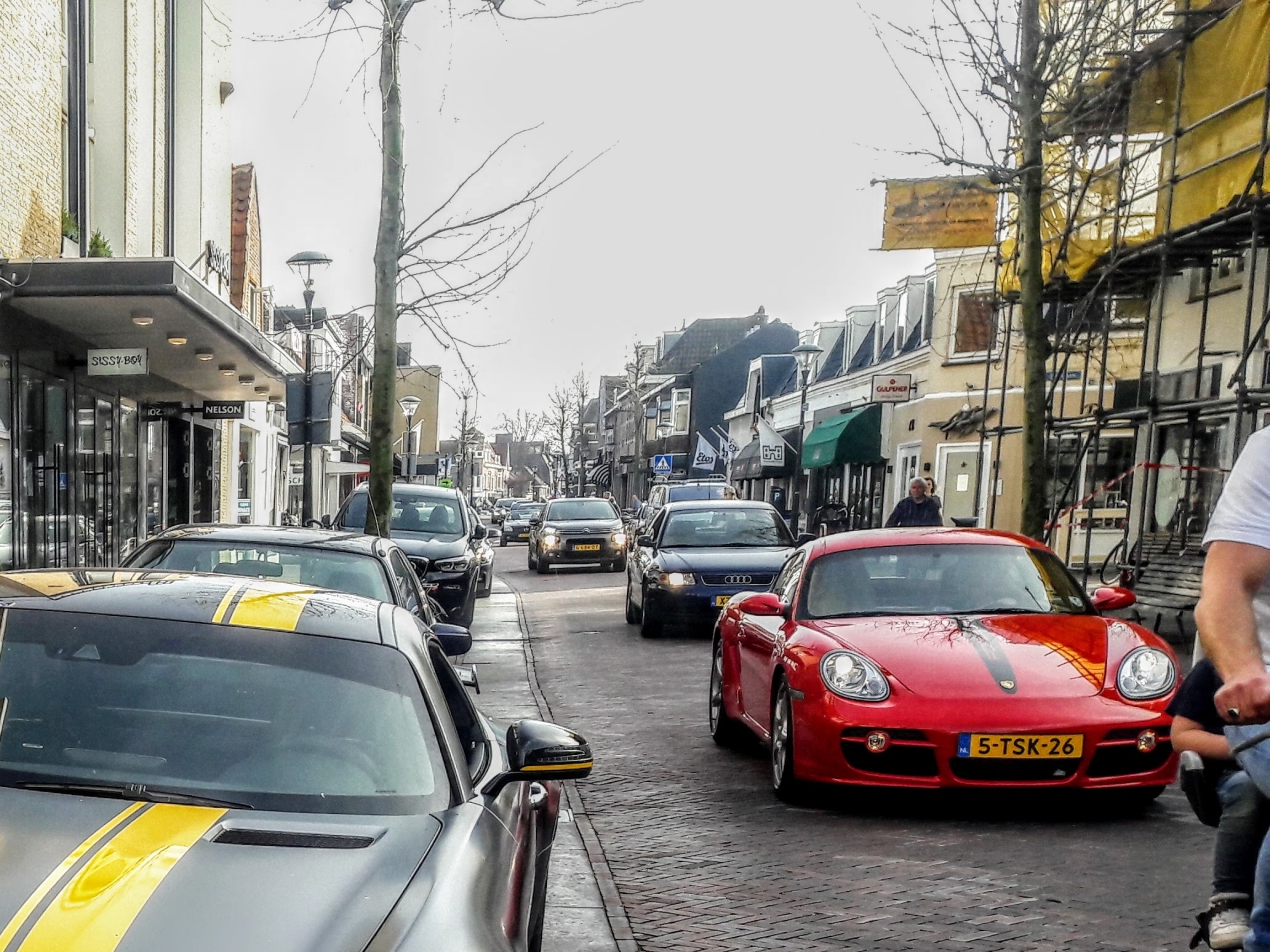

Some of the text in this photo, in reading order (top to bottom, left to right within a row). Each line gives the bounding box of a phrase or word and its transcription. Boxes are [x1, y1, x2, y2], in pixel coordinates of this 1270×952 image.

[91, 354, 142, 368] SISSY-BOY
[205, 405, 242, 415] NELSON
[696, 452, 714, 464] Etos
[978, 738, 1075, 755] 5-TSK-26
